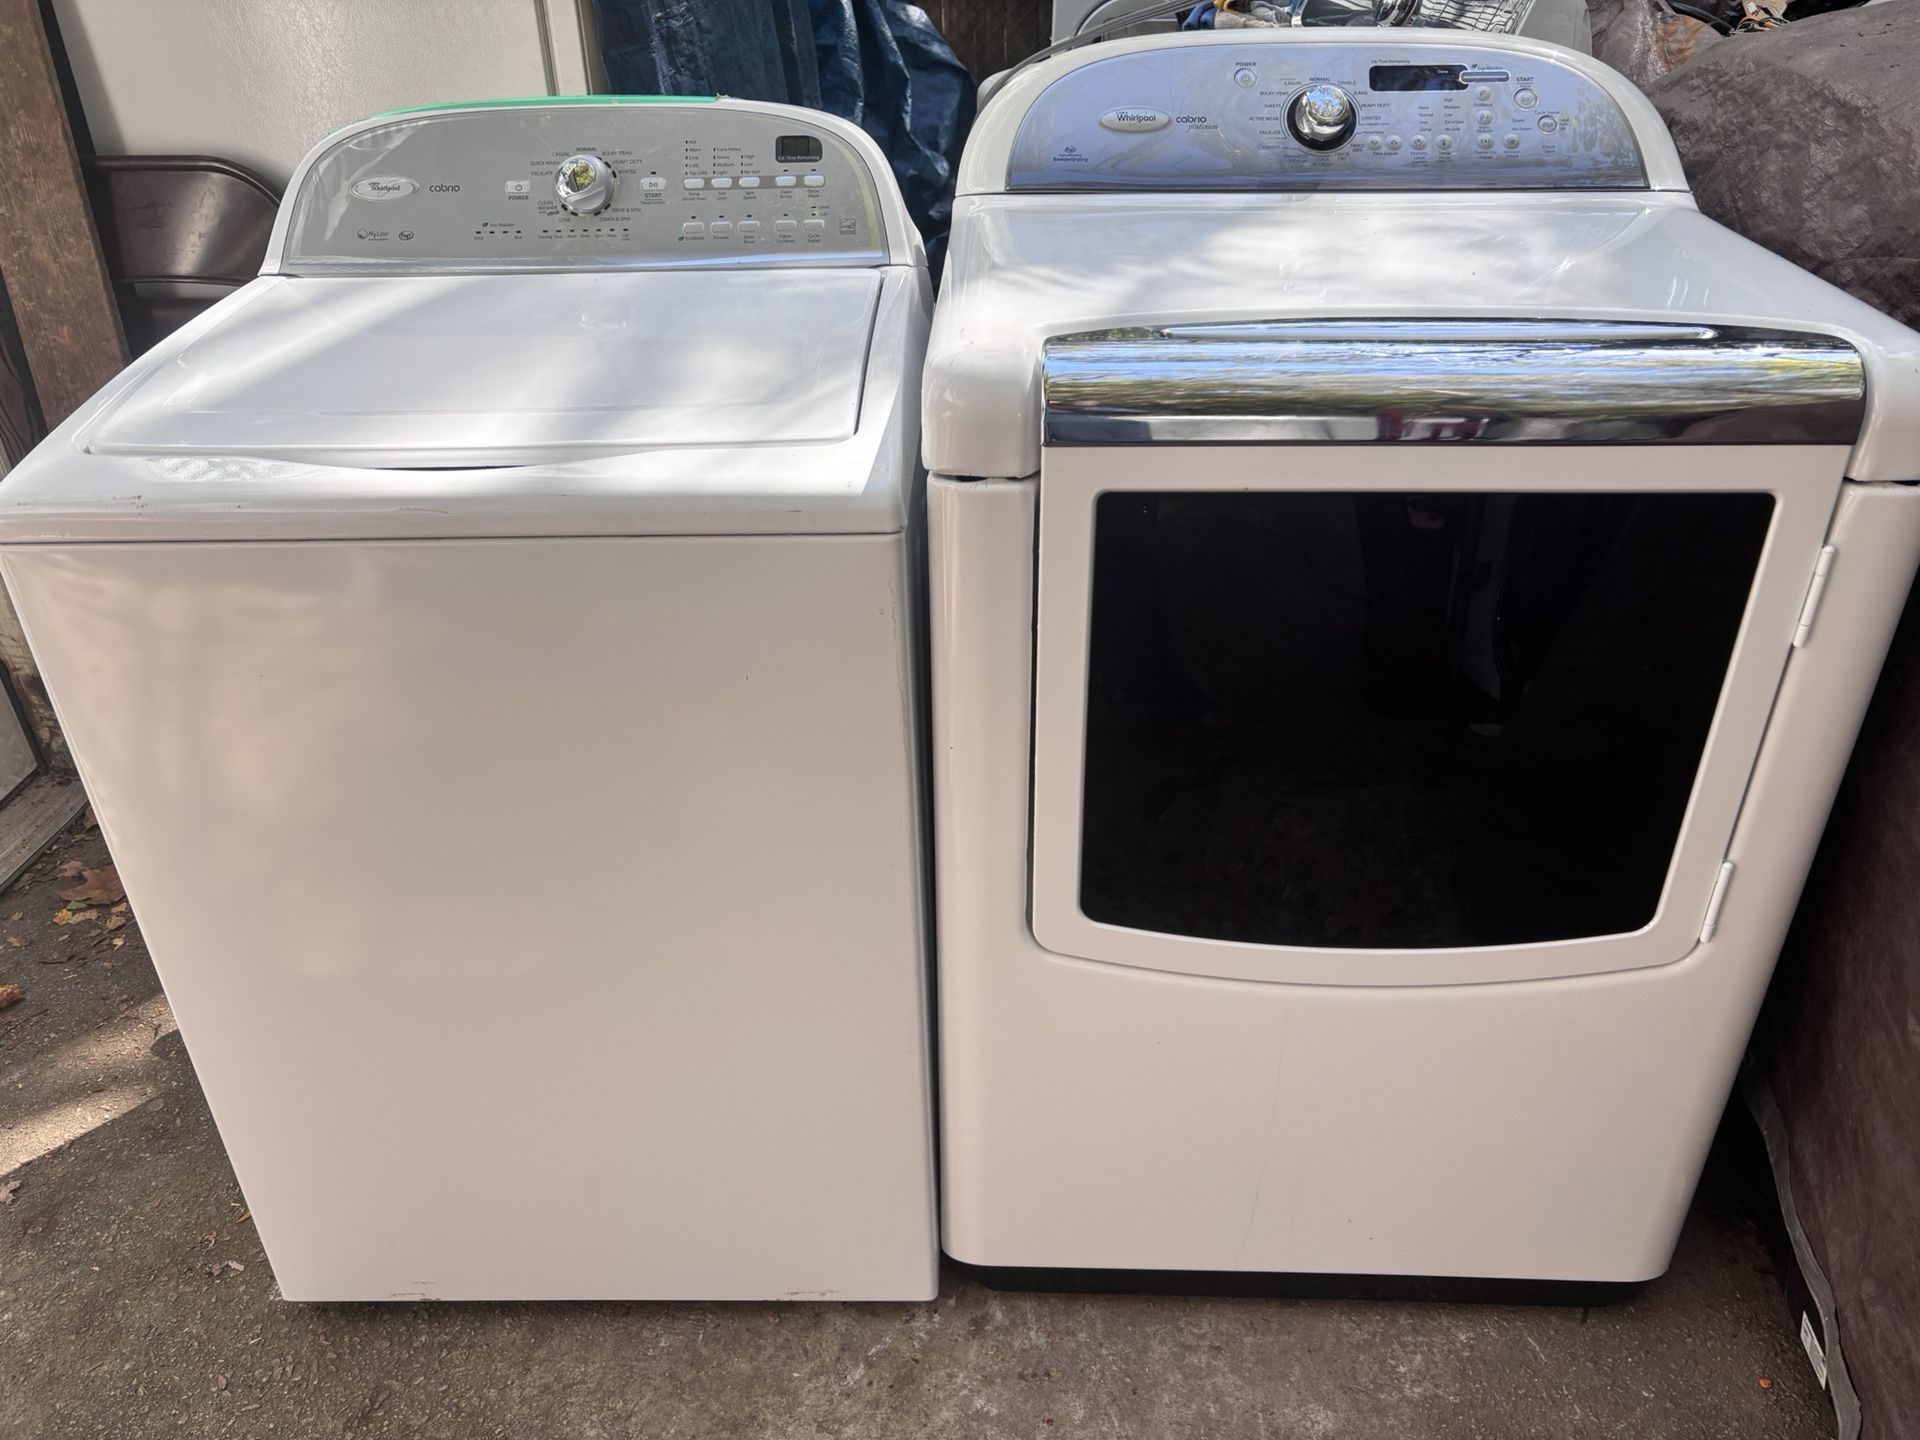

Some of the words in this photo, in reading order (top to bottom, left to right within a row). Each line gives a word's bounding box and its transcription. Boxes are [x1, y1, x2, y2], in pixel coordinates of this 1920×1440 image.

[1117, 112, 1156, 124] Whirlpool
[1176, 114, 1207, 124] cabrio
[1186, 124, 1218, 133] platinum
[369, 182, 400, 194] Whirlpool
[429, 184, 461, 193] cabrio
